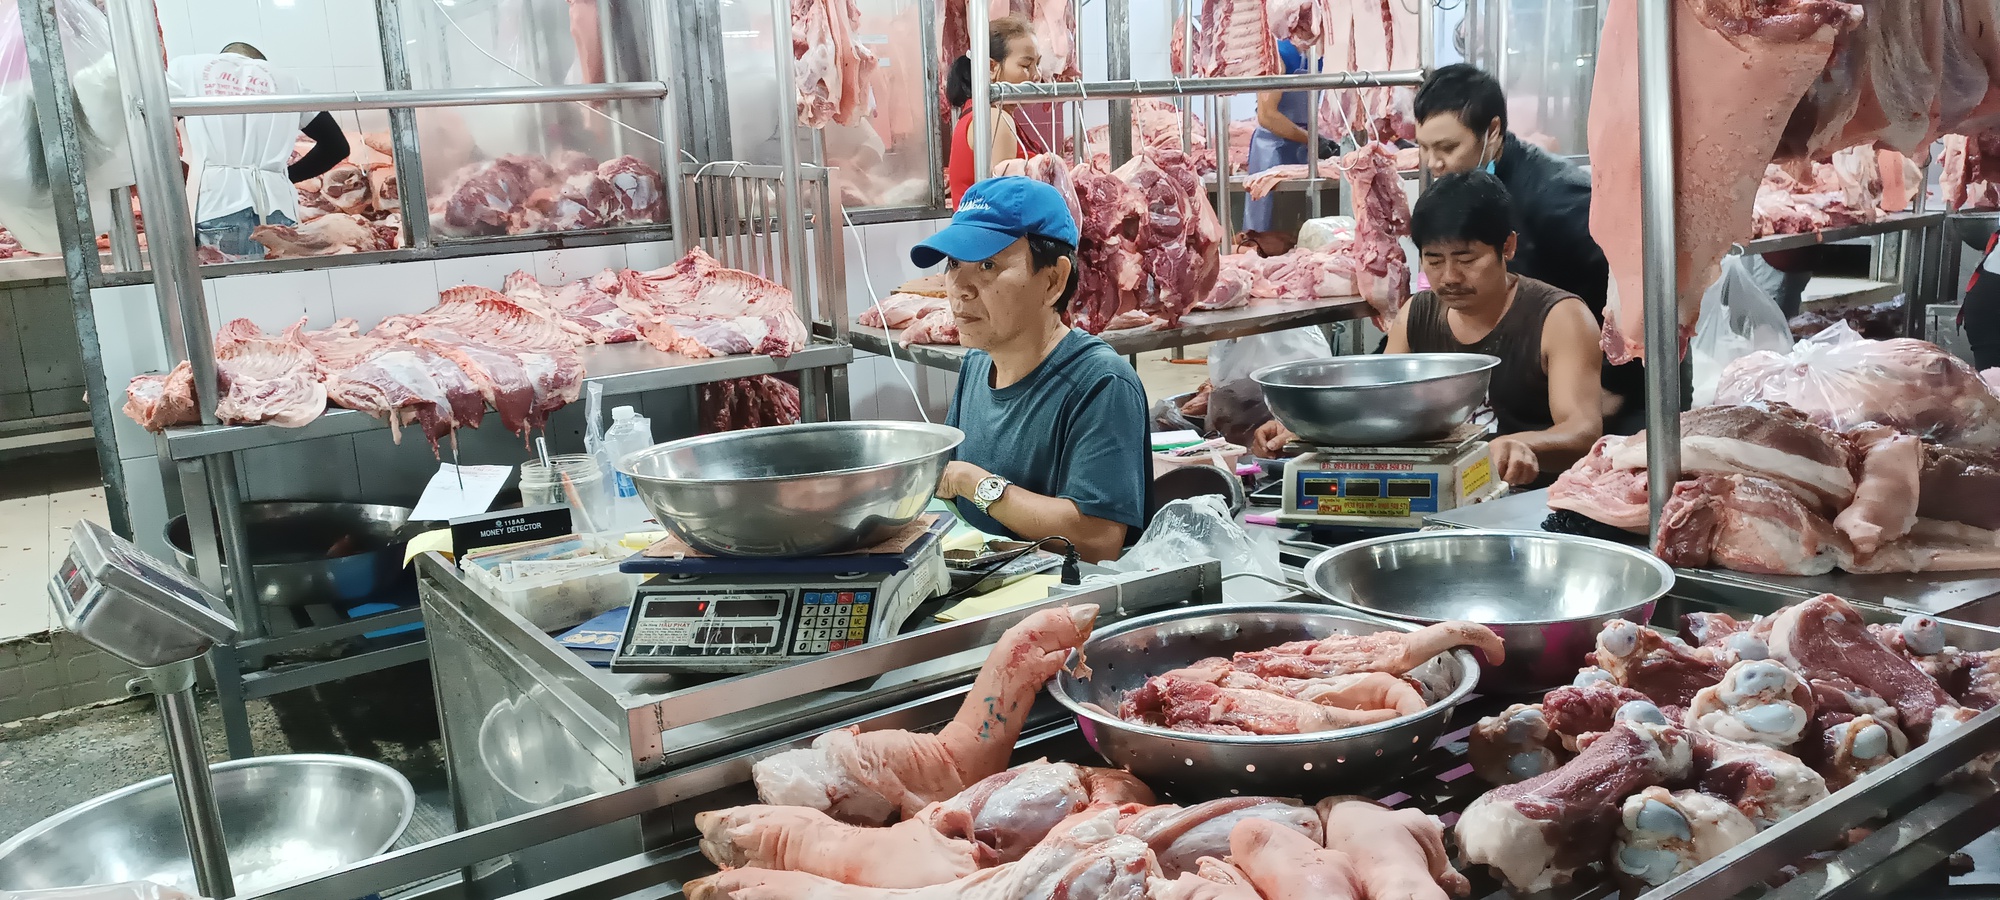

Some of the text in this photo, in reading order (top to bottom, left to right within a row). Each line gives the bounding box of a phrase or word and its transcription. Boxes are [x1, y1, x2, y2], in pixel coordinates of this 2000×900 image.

[480, 522, 542, 538] MONEY DETECTOR
[823, 606, 831, 614] 8
[839, 606, 847, 614] 9
[803, 618, 812, 626] 4
[820, 618, 829, 626] 5
[837, 618, 845, 626] 6
[803, 630, 809, 638] 1
[818, 630, 826, 638] 2
[835, 630, 843, 638] 3
[799, 642, 807, 650] 0
